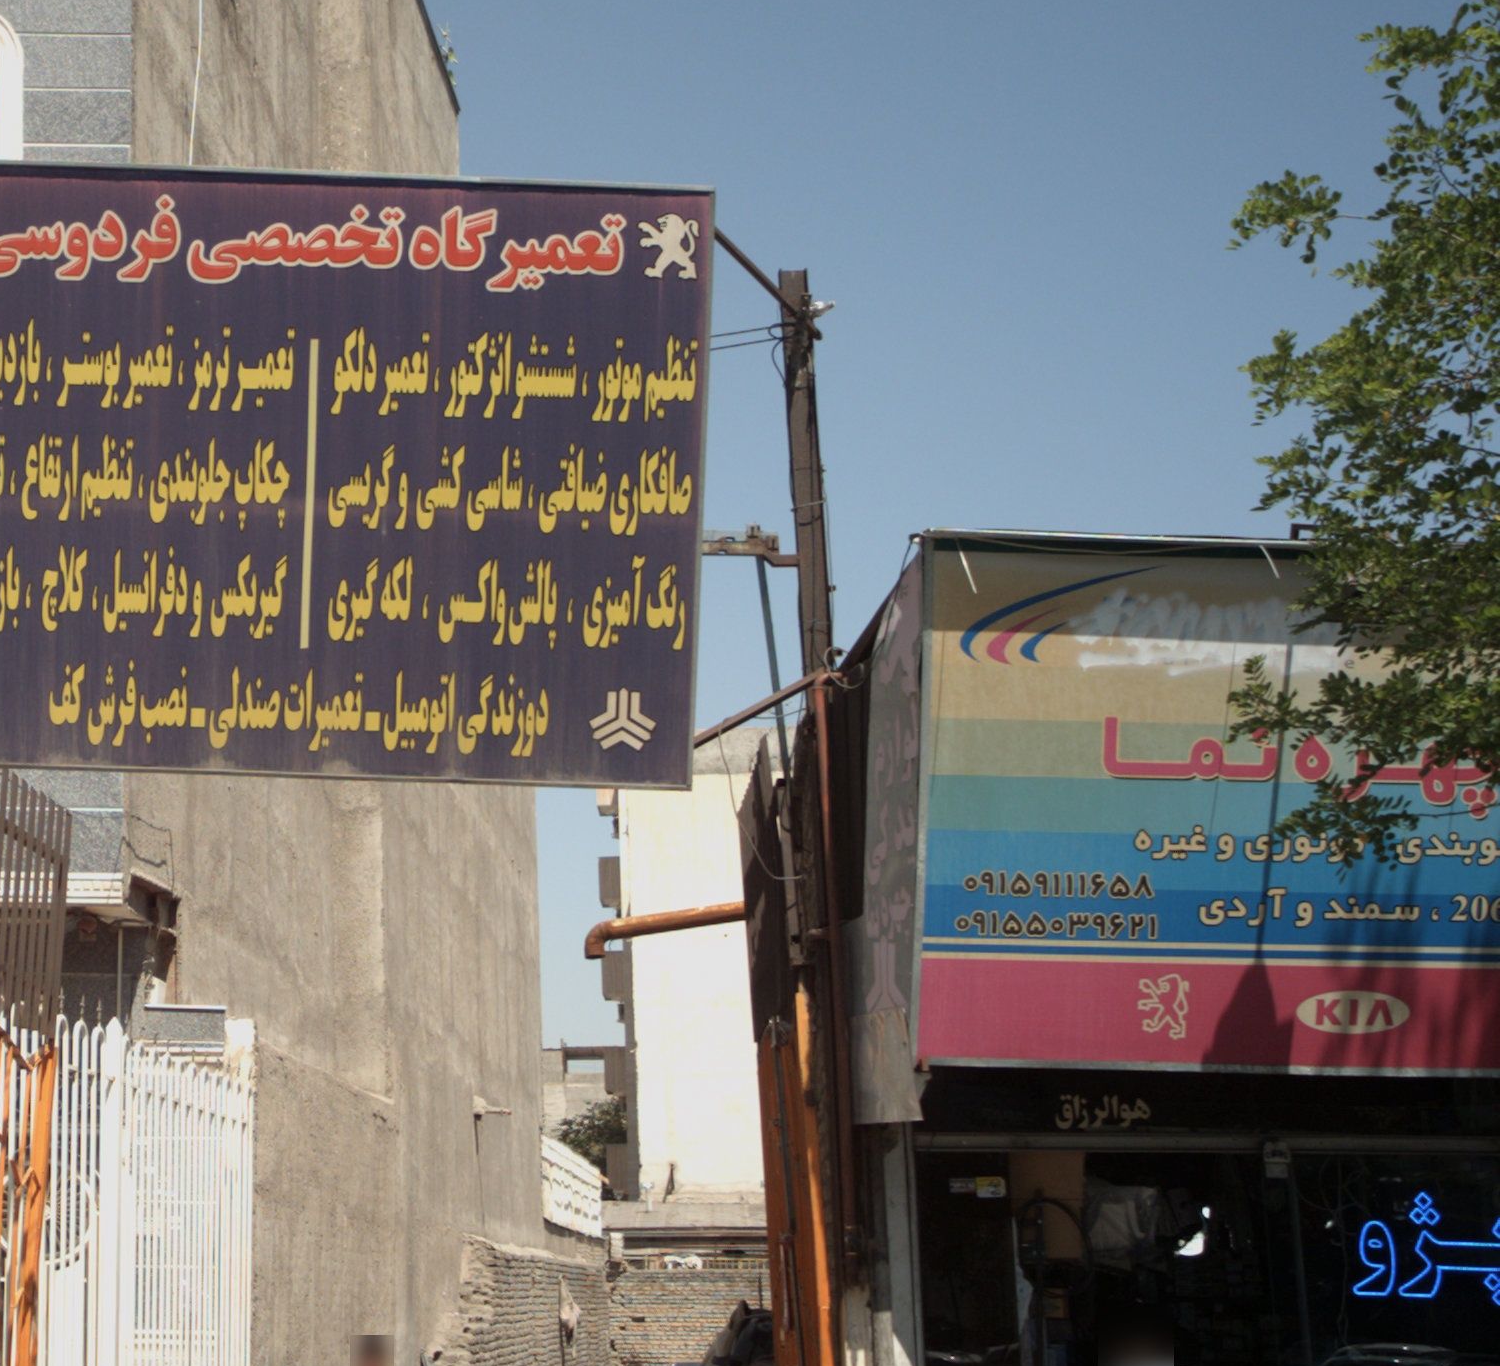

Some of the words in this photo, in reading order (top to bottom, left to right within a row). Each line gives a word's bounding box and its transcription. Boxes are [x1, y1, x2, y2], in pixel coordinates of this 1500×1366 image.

[186, 203, 406, 284] تخصصی
[55, 330, 122, 410] بوستر
[121, 324, 175, 411] تعمیر
[187, 325, 233, 413] ترمز
[230, 328, 297, 413] تعمیر
[329, 327, 379, 416] دلکو
[377, 331, 432, 417] تعمیر
[442, 331, 513, 420] انژکتور
[510, 334, 578, 421] شستشو
[590, 337, 644, 424] موتور
[643, 337, 700, 421] تنظیم
[19, 434, 80, 523] ارتفاع
[79, 434, 135, 521] تنظیم
[147, 438, 233, 526] جلوبندی
[232, 440, 292, 530] چکاپ
[326, 444, 396, 531] گریسی
[394, 472, 410, 531] و
[414, 444, 467, 531] کشی
[464, 447, 524, 533] شاسی
[608, 446, 694, 537] صافکاری
[40, 545, 89, 633] کلاچ
[101, 546, 190, 638] دفرانسیل
[188, 579, 204, 638] و
[209, 553, 289, 641] گیربکس
[326, 559, 380, 643] گیری
[378, 556, 415, 622] لکه
[437, 559, 507, 647] واکس
[507, 560, 559, 650] پالش
[581, 554, 647, 650] آمیزی
[644, 564, 687, 652] رنگ
[47, 662, 87, 727] کف
[85, 659, 138, 749] فرش
[138, 665, 189, 744] نصب
[207, 666, 282, 750] صندلی
[282, 670, 365, 753] تعمیرات
[382, 670, 457, 755] اتومبیل
[456, 674, 550, 758] دوزندگی
[1102, 715, 1279, 782] نما
[962, 868, 1156, 899] ۰۹۱۵۹۱۱۱۶۵۸
[1133, 824, 1207, 860] غیره
[1214, 833, 1236, 862] و
[1395, 831, 1500, 866] وبندی
[954, 909, 1159, 940] ۰۹۱۵۵۰۳۹۶۲۱
[1199, 887, 1288, 927] آردی
[1294, 899, 1314, 928] و
[1323, 896, 1421, 922] سمند
[1314, 998, 1395, 1027] KIA
[1352, 1191, 1500, 1307] ژو
